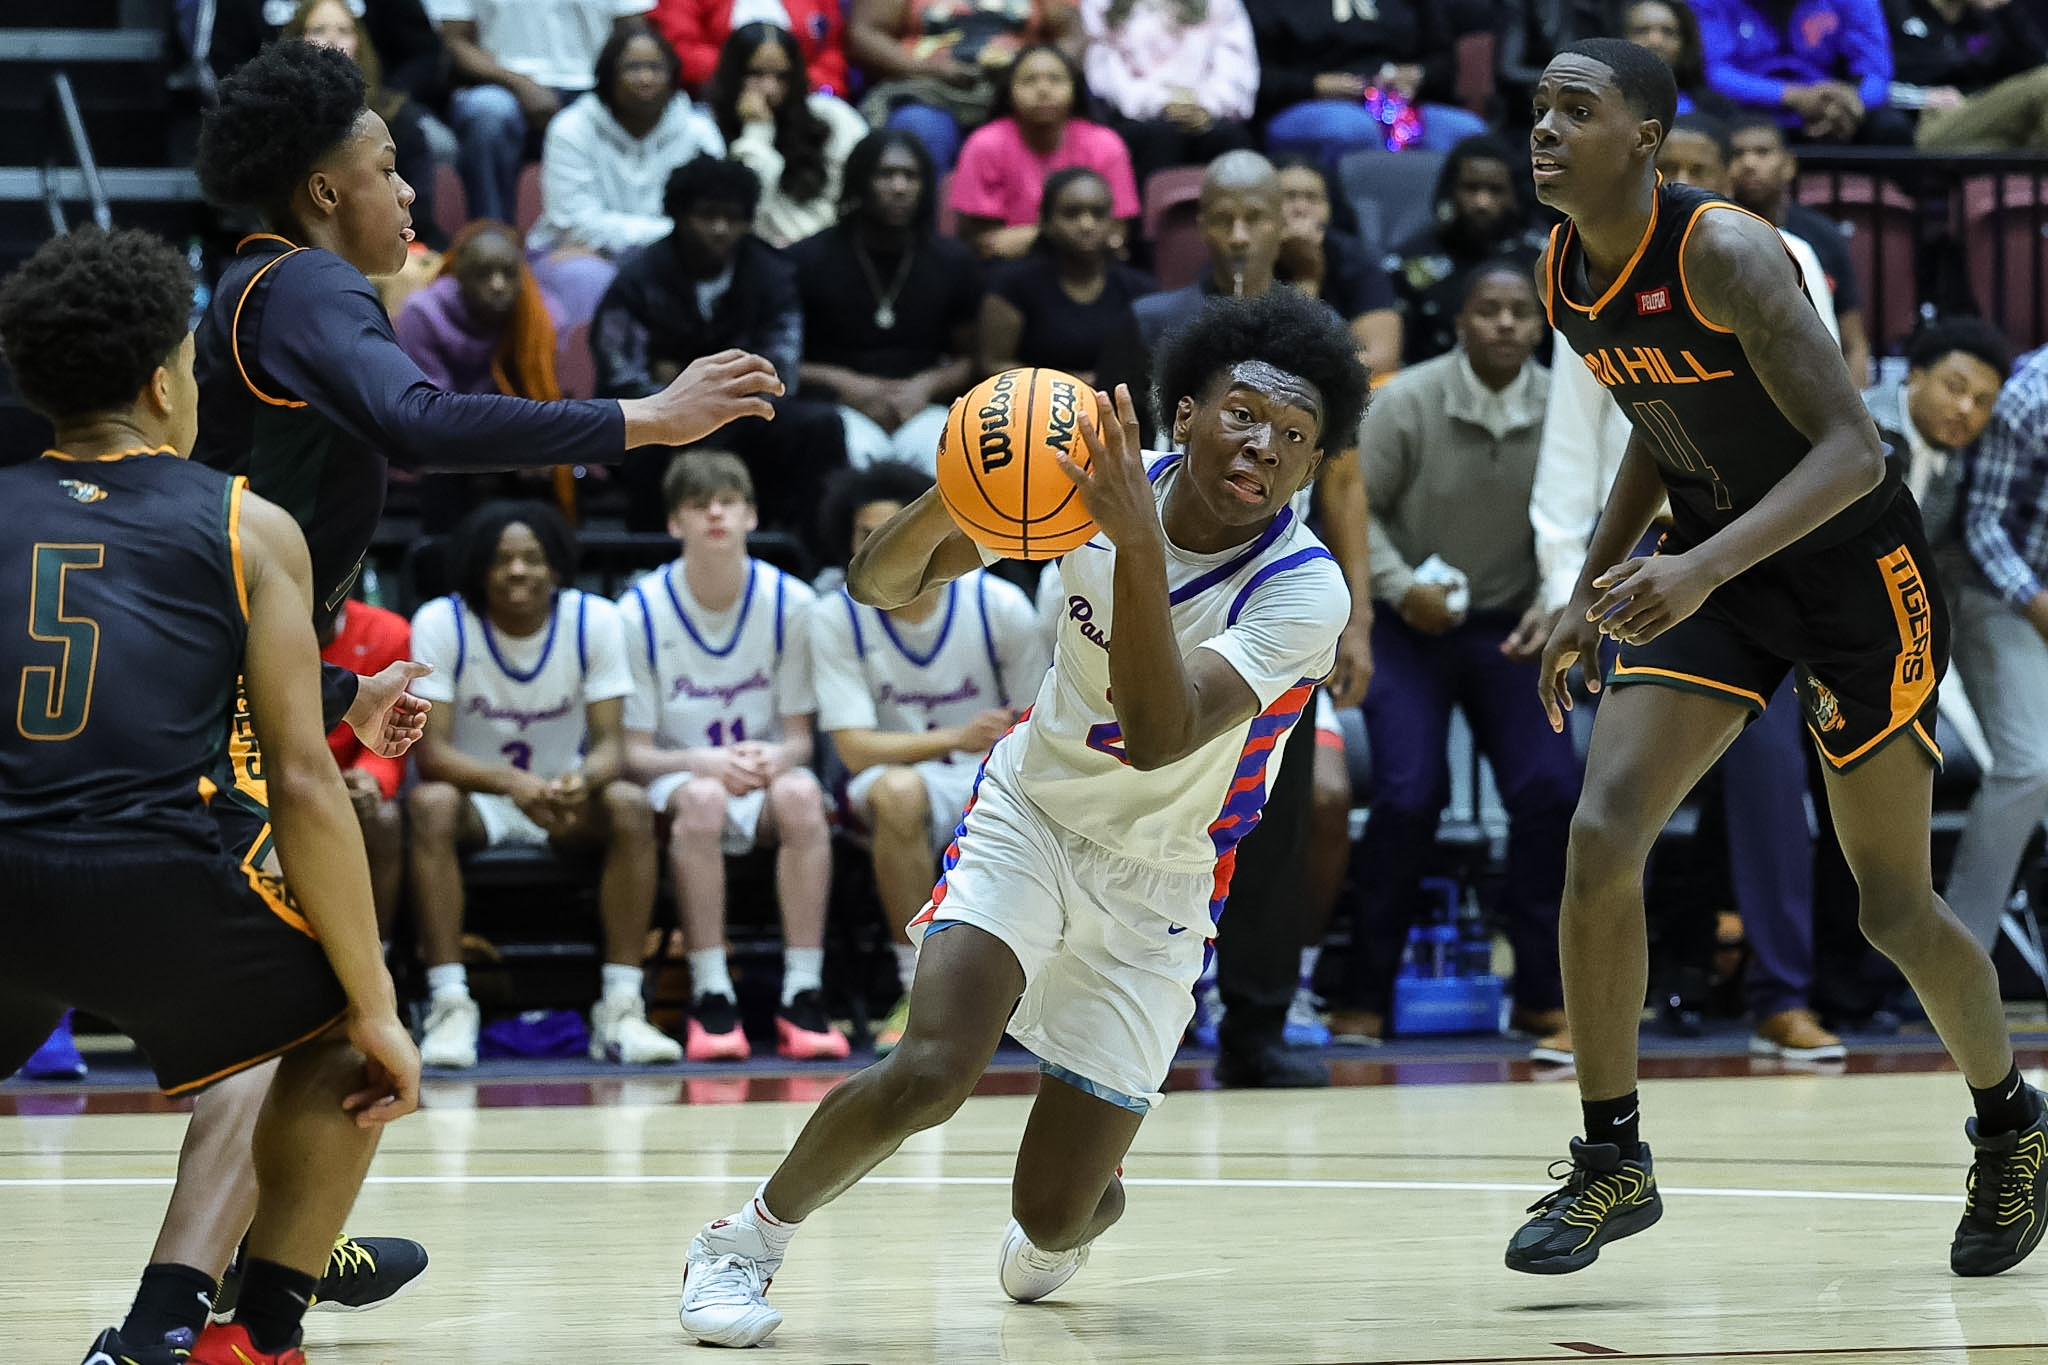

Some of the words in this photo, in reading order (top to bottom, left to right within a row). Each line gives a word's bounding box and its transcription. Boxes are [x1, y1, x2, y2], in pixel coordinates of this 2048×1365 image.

[1614, 347, 1735, 384] HILL
[979, 370, 1022, 475] Wilson
[1045, 381, 1077, 456] NCAA
[16, 541, 105, 741] 5
[1890, 549, 1930, 684] TIGERS
[706, 720, 746, 747] 11
